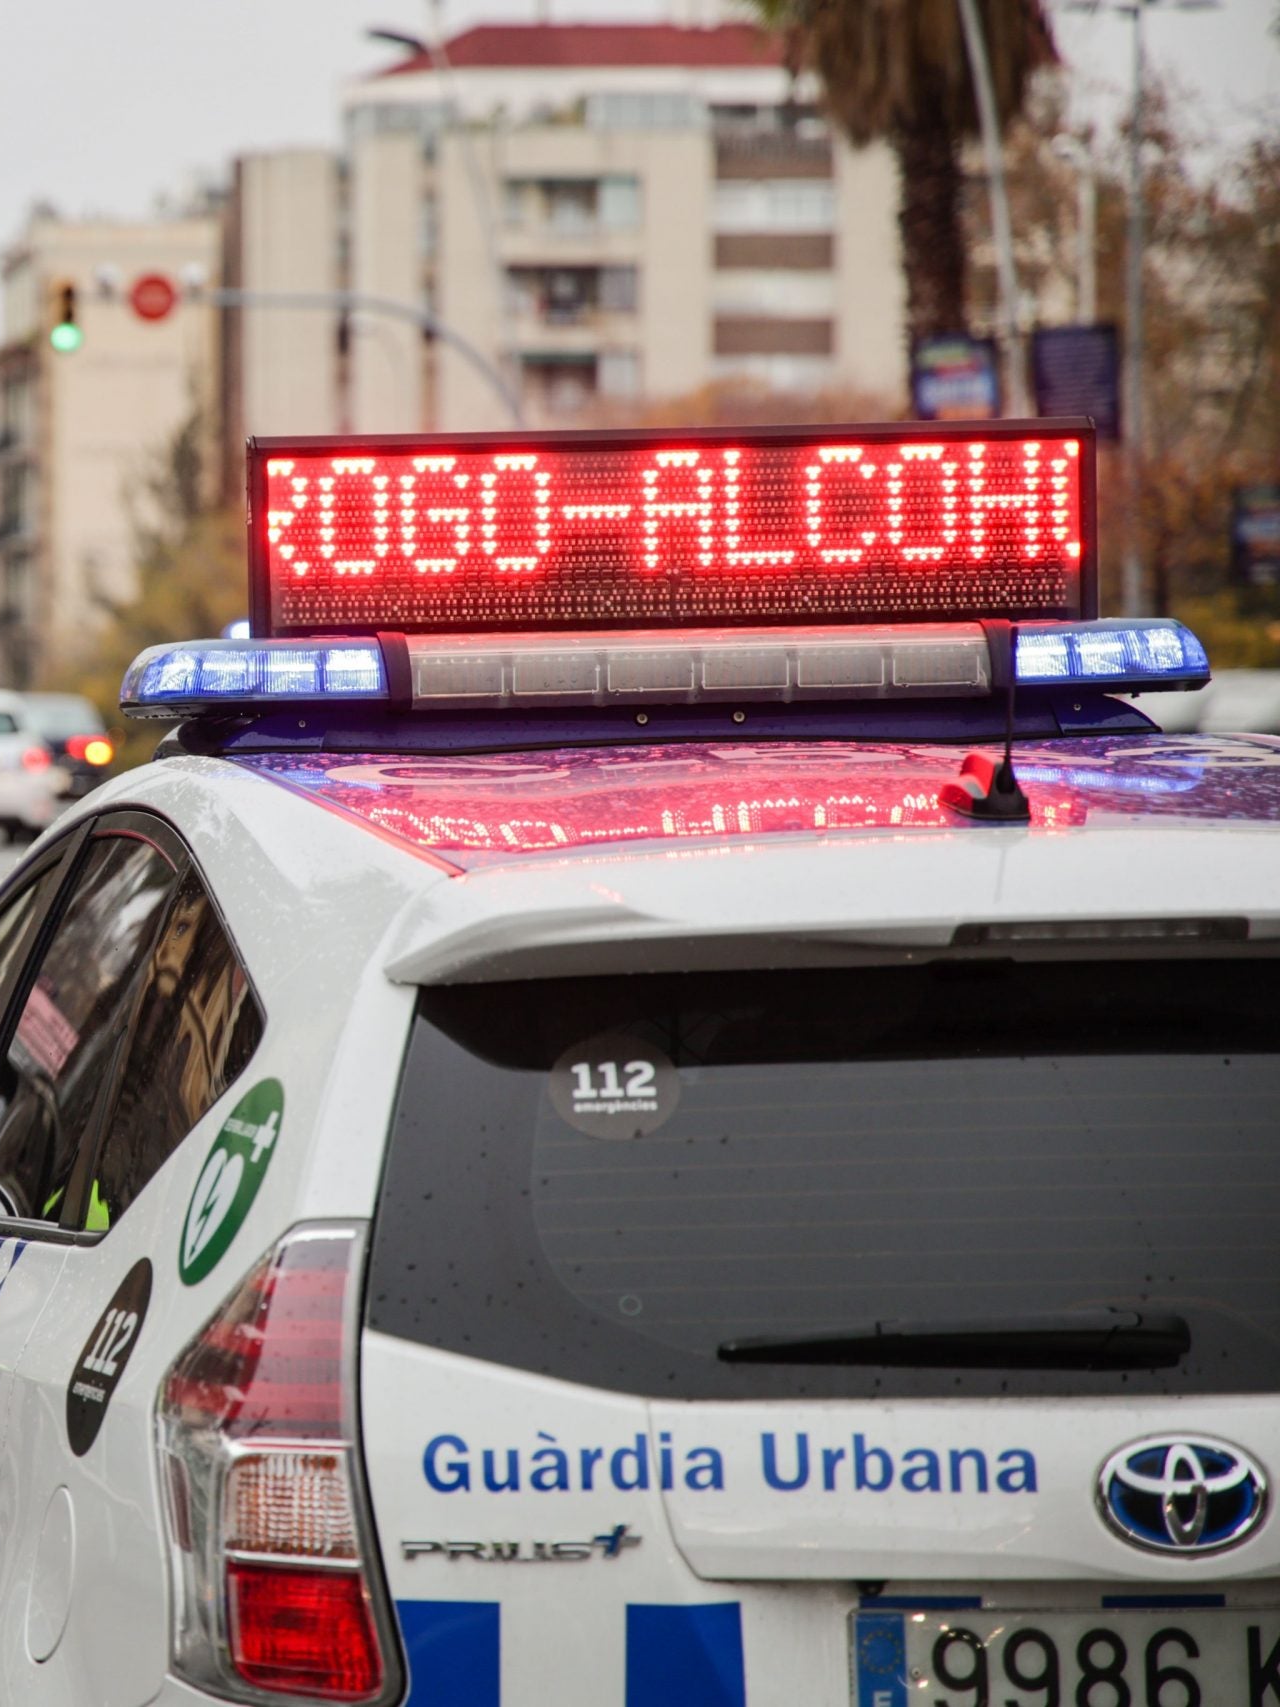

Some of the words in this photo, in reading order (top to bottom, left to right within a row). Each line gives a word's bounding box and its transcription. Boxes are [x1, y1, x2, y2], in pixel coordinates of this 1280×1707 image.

[571, 1060, 657, 1099] 112
[83, 1308, 138, 1377] 112
[422, 1430, 725, 1493] Guàrdia
[759, 1432, 1039, 1493] Urbana
[932, 1627, 1202, 1707] 9986
